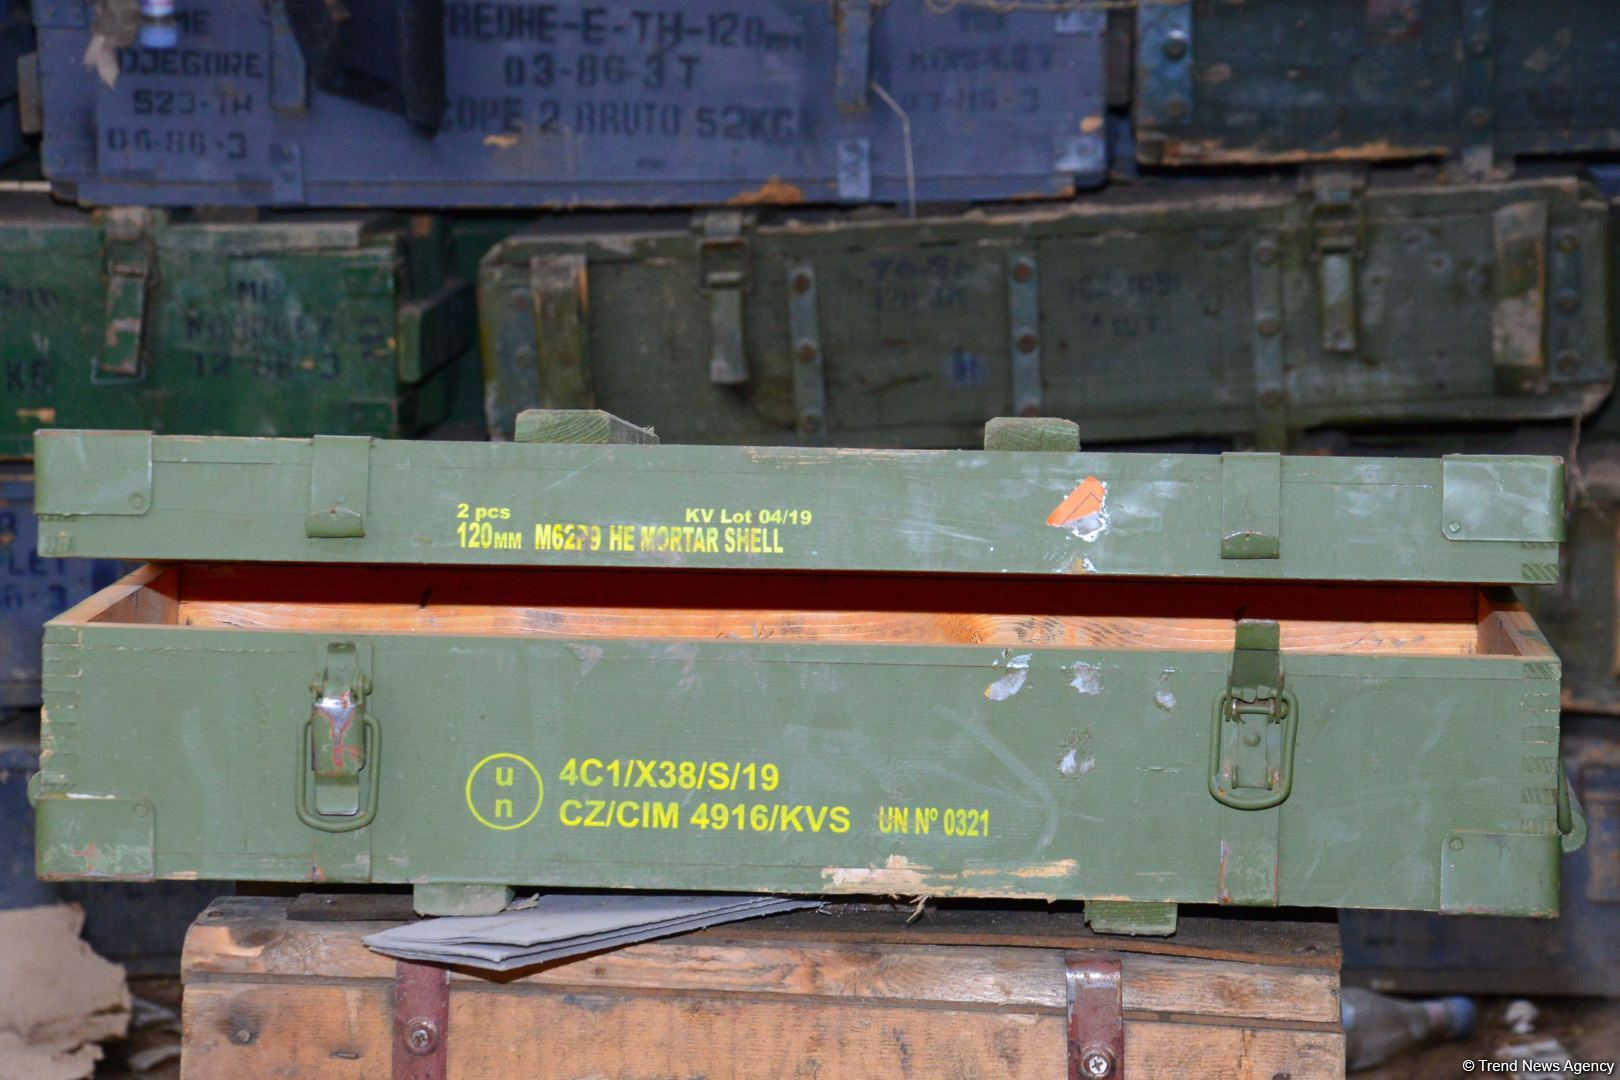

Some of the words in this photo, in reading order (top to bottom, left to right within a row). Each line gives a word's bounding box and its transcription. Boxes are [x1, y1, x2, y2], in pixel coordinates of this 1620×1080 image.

[456, 502, 470, 519] 2
[475, 505, 511, 520] pcs
[685, 508, 714, 524] KV
[720, 509, 752, 524] Lot
[758, 510, 813, 525] 04/19
[608, 524, 635, 552] HE
[640, 525, 719, 553] MORTAR
[724, 526, 784, 554] SHELL
[495, 767, 514, 787] u
[559, 758, 779, 791] 4C1/X38/S/19
[495, 798, 513, 818] n
[559, 799, 679, 830] CZ/CIM
[690, 802, 852, 834] 4916/KVS
[878, 806, 909, 834] UN
[944, 808, 990, 837] 0321
